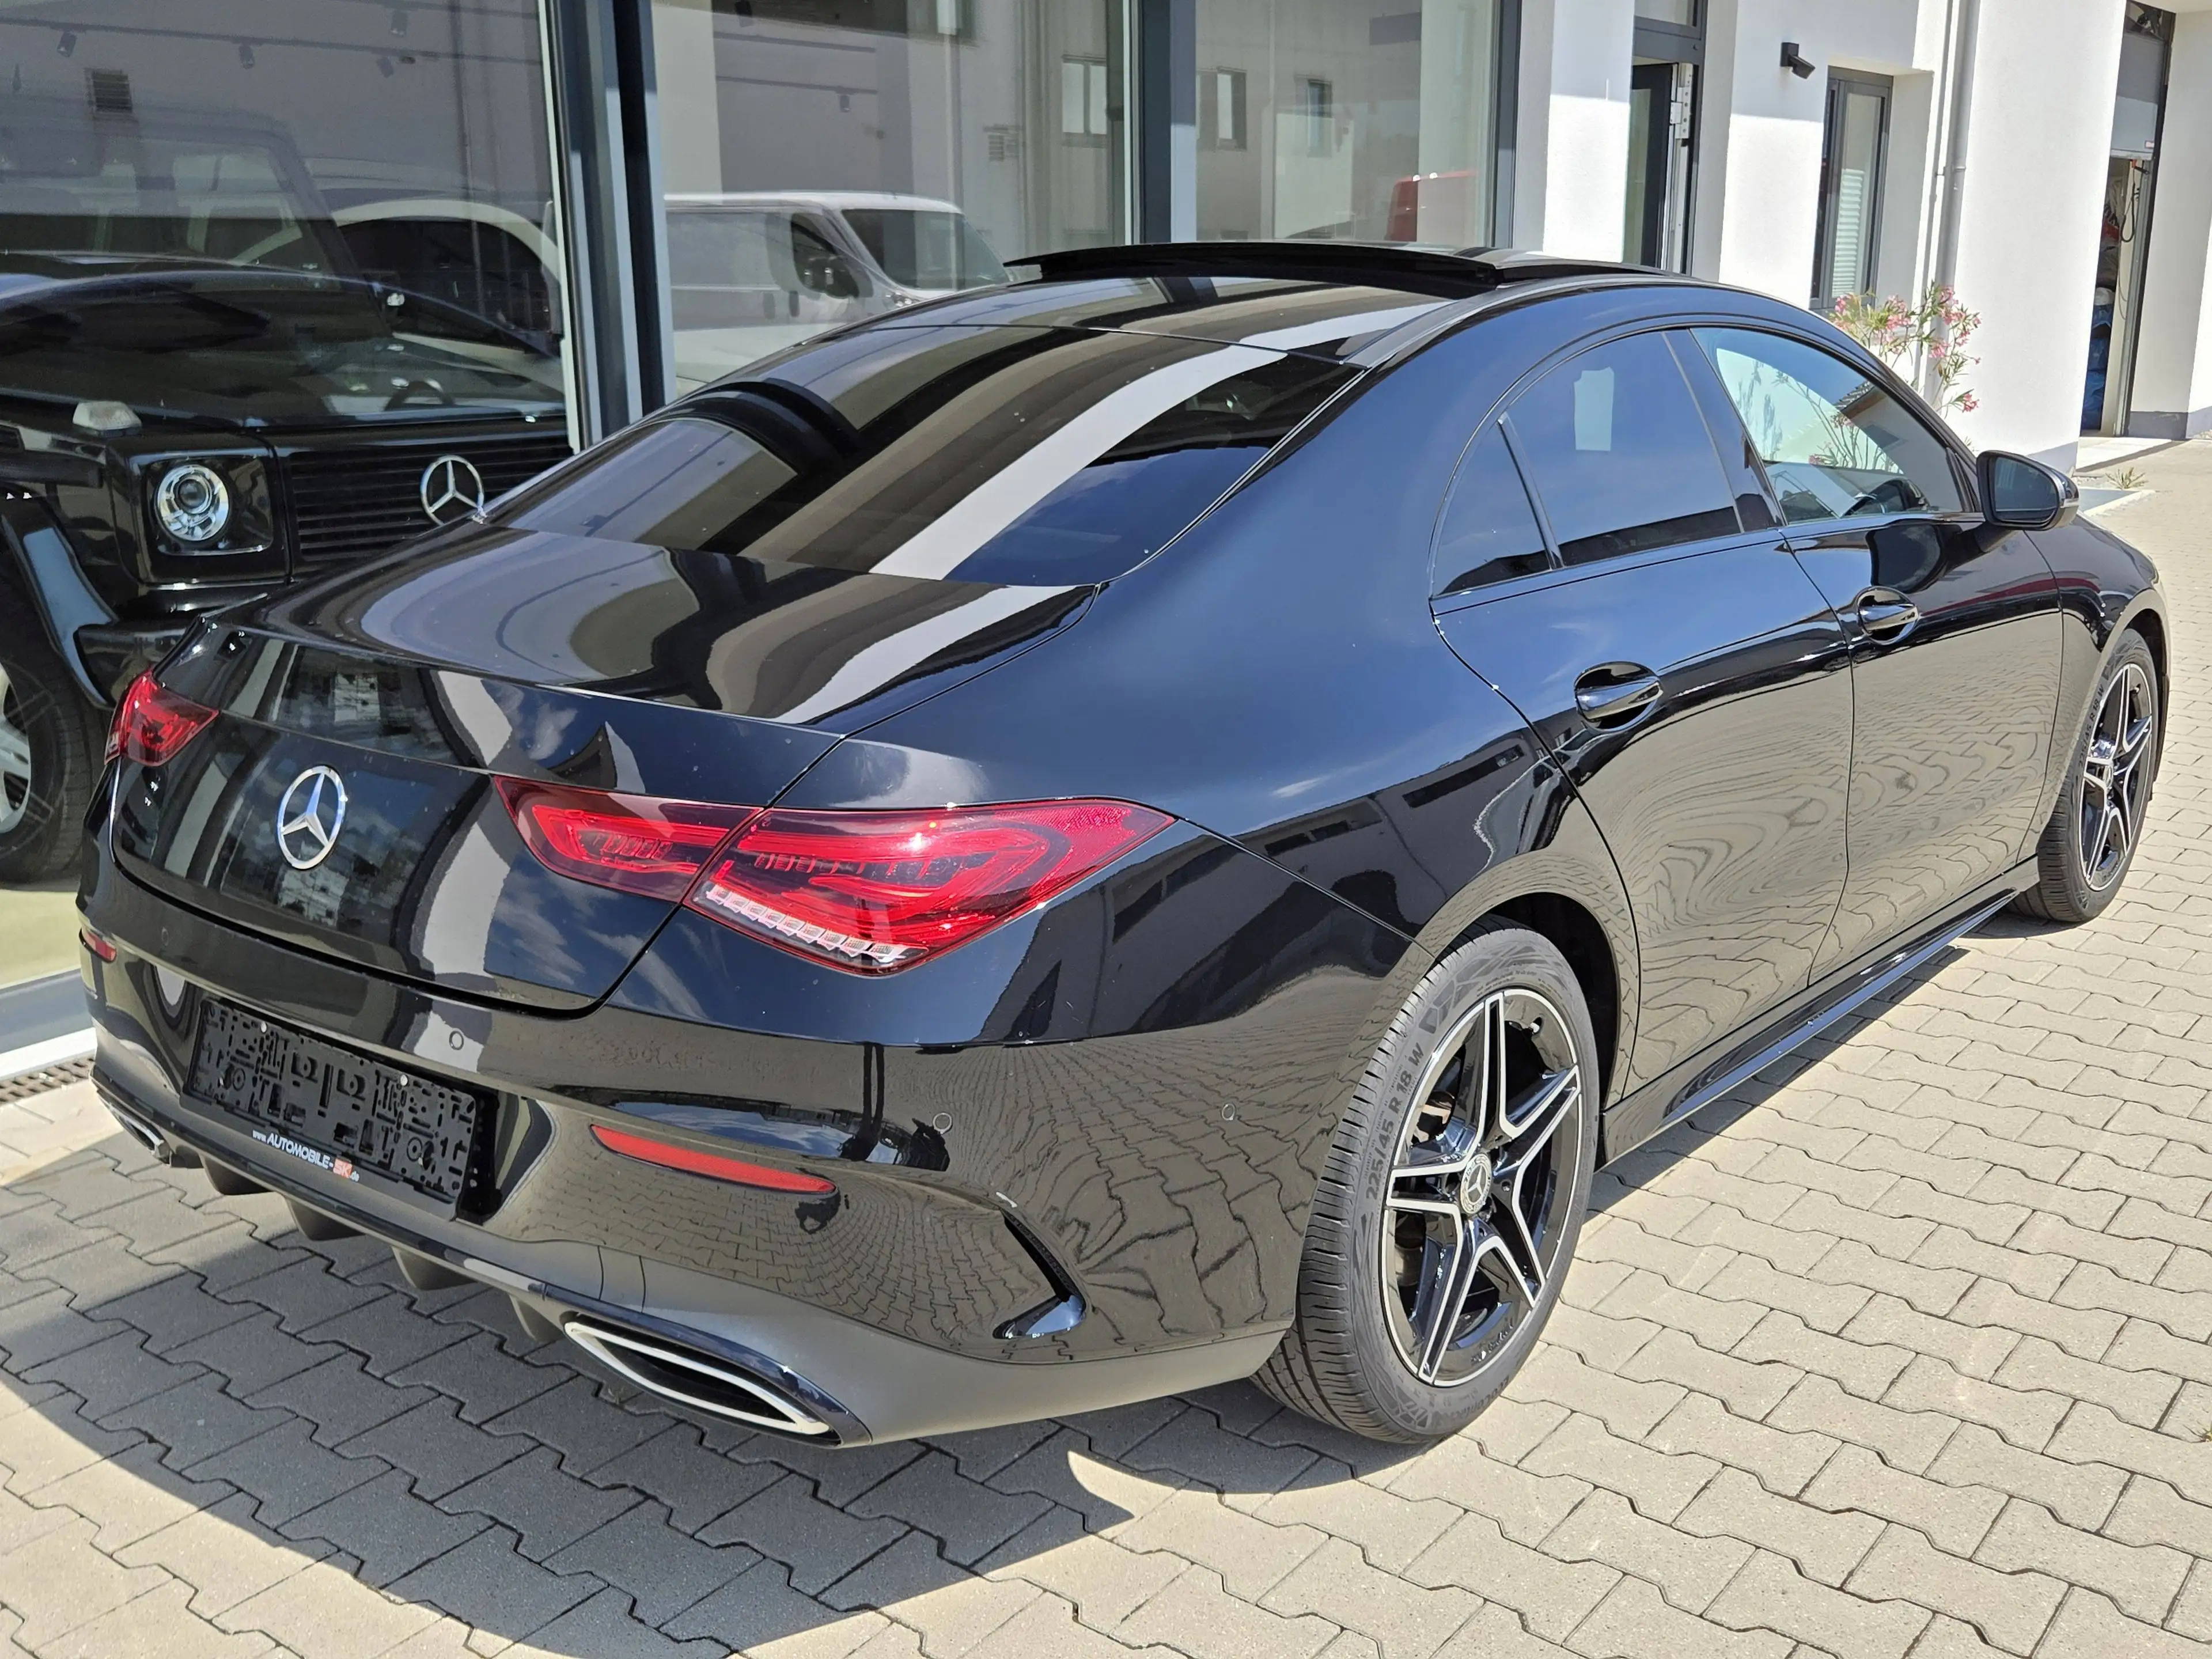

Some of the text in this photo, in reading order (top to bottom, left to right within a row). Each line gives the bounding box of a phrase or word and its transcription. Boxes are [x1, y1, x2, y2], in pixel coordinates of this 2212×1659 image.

[1366, 1119, 1395, 1200] 225/45
[1388, 1097, 1403, 1115] R
[1396, 1070, 1412, 1096] 18
[1408, 1042, 1424, 1066] W
